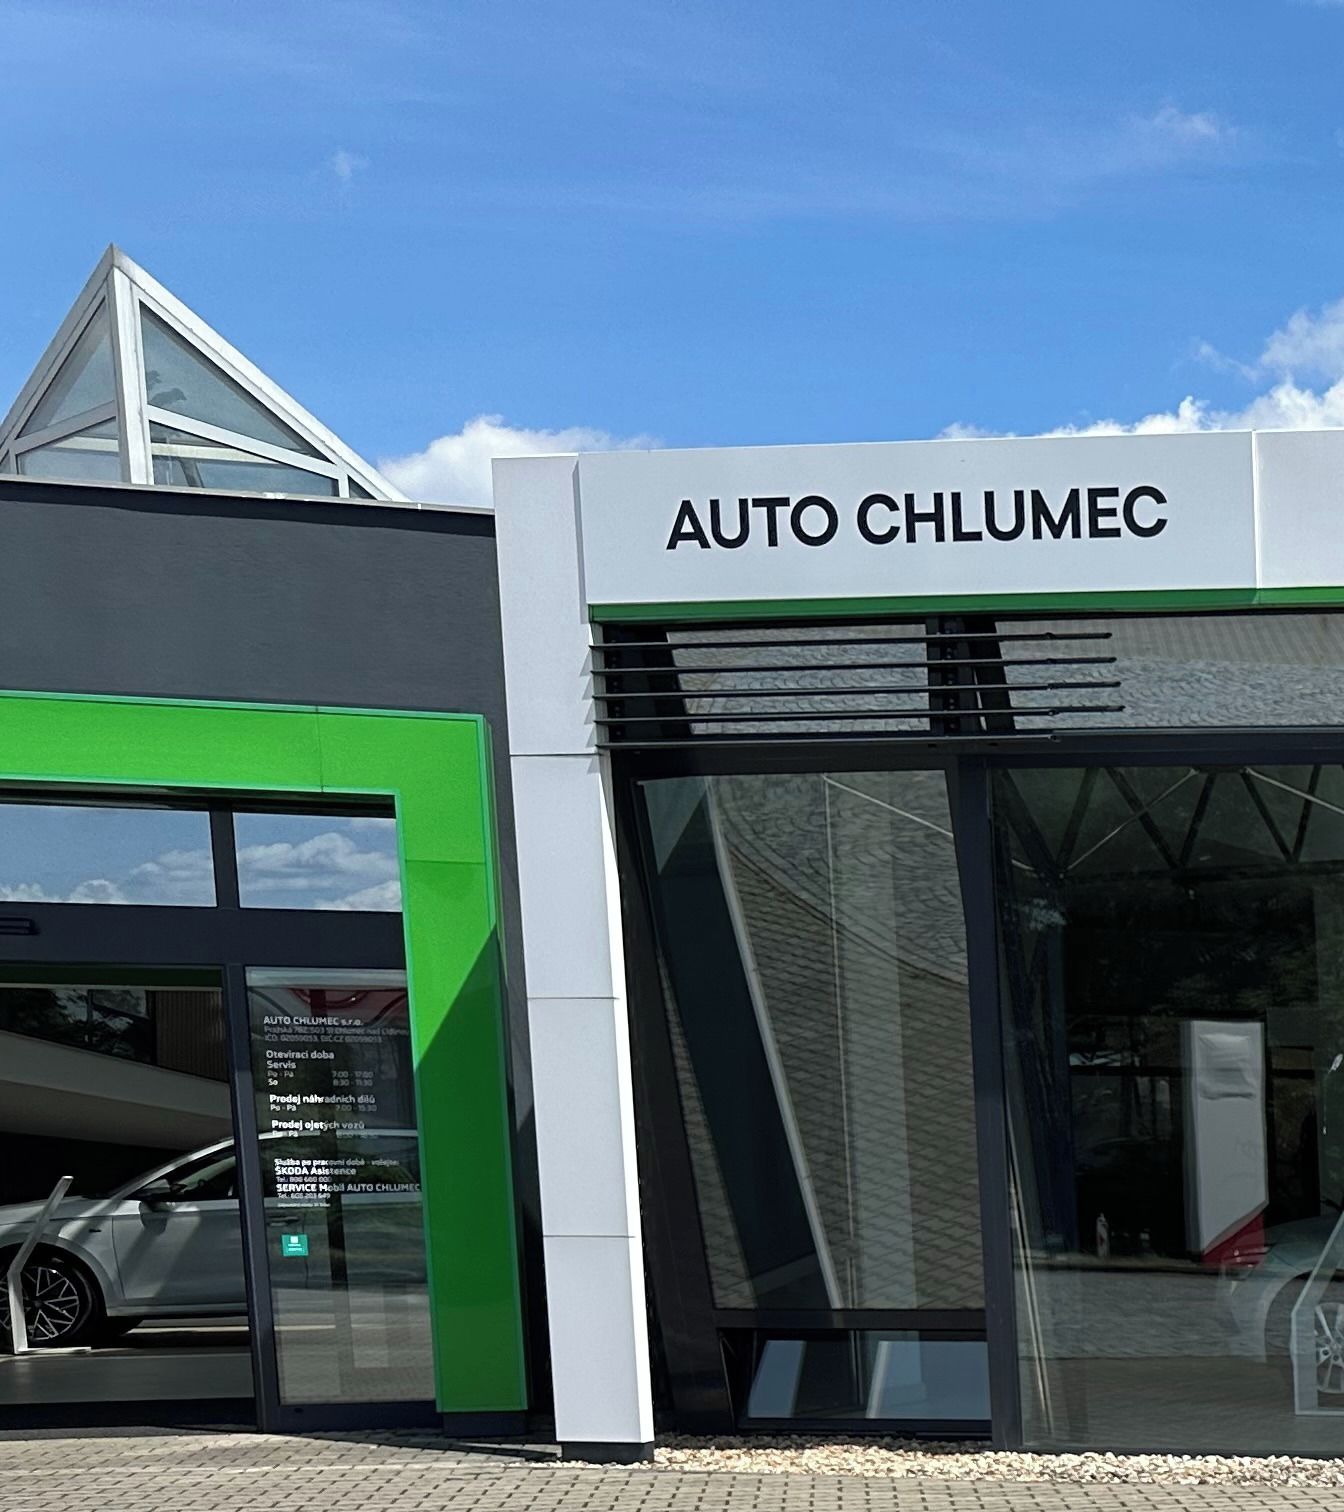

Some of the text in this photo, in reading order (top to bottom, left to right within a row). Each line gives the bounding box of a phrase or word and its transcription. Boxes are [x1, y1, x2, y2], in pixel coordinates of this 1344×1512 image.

[665, 485, 1169, 550] AUTO CHLUMEC
[263, 1016, 291, 1025] AUTO
[293, 1016, 339, 1025] CHLUMEC
[310, 1050, 335, 1059] doba
[266, 1060, 297, 1069] Servis
[270, 1094, 300, 1105] Prodej
[272, 1120, 303, 1130] Prodej
[276, 1183, 317, 1192] SERVICE
[347, 1183, 374, 1192] AUTO
